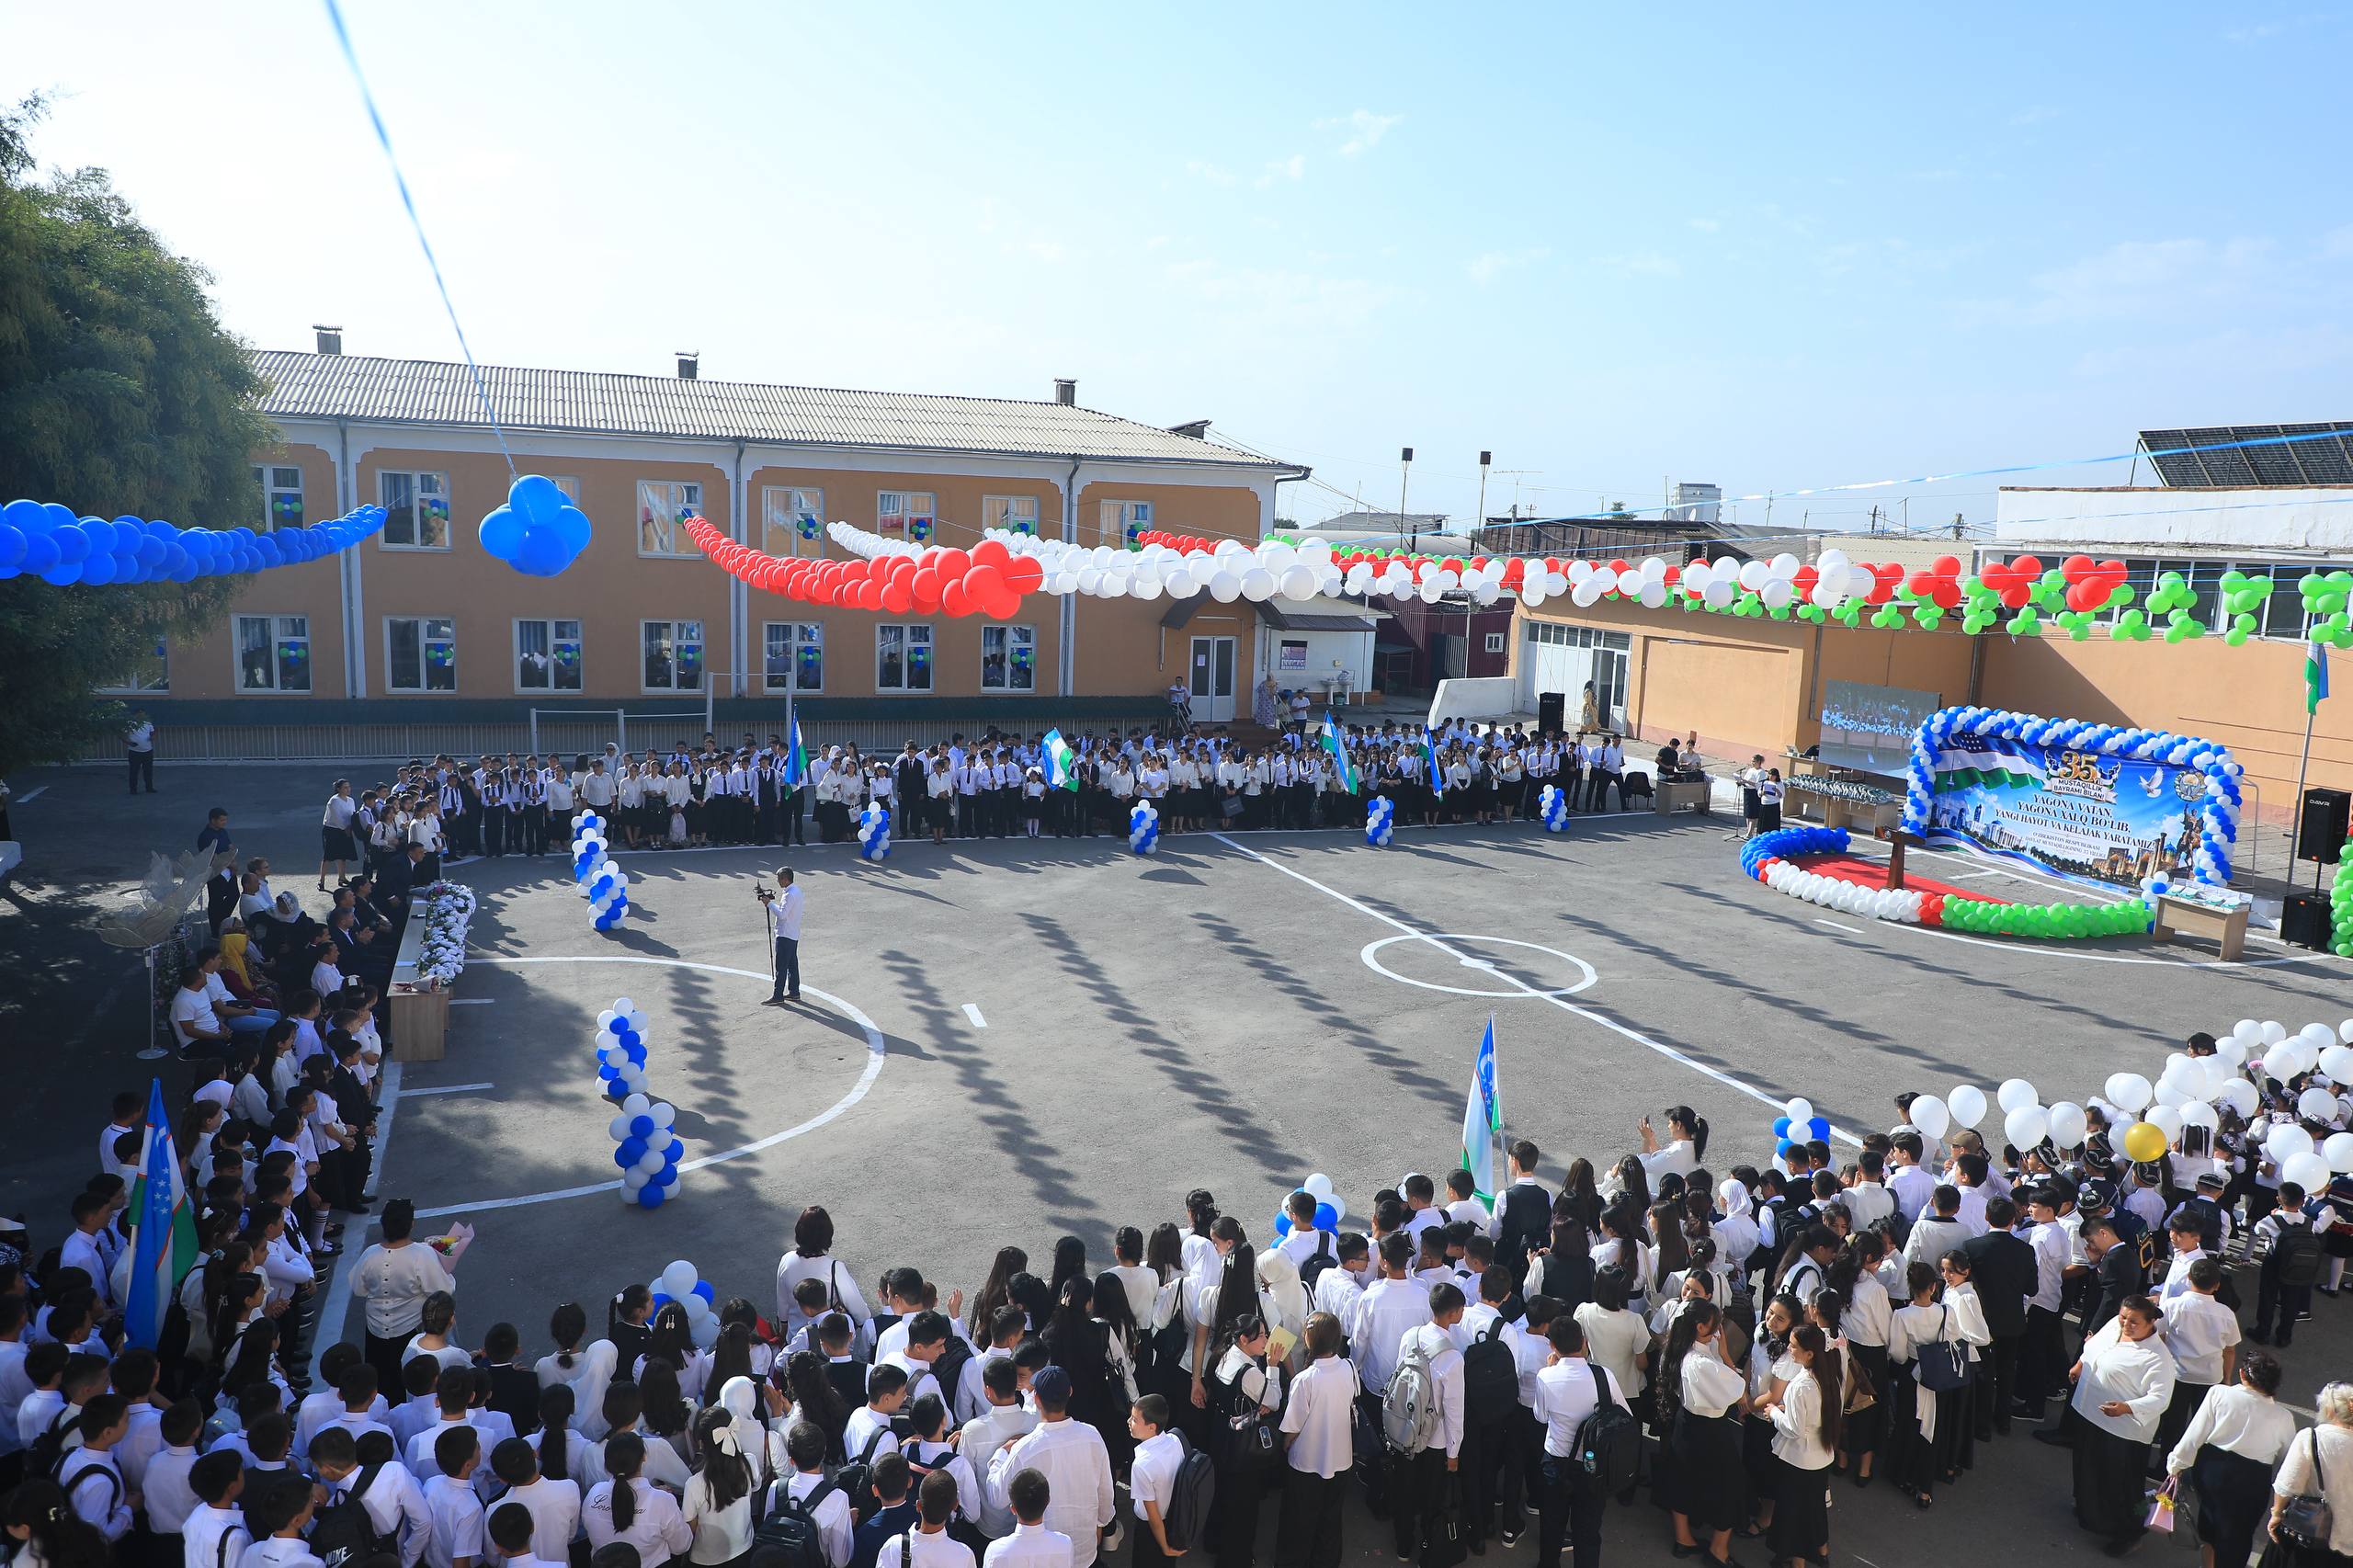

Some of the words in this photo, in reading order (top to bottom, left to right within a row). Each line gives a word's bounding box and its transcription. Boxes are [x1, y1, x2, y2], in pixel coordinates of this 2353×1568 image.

[2059, 750, 2097, 781] 35
[2053, 785, 2082, 794] BAYRAMI
[2058, 779, 2103, 792] MUSTAQILLIK
[2033, 794, 2075, 810] YAGONA
[2018, 801, 2058, 817] YAGONA
[2060, 810, 2088, 825] XALQ
[1995, 809, 2019, 821] YANGI
[2021, 814, 2049, 827] HAYOT
[2051, 820, 2061, 830] VA
[2063, 824, 2100, 838] KELAJAK
[2103, 832, 2155, 850] YARATAMIZ!
[591, 1494, 610, 1511] Loro
[326, 1546, 347, 1565] NIKE
